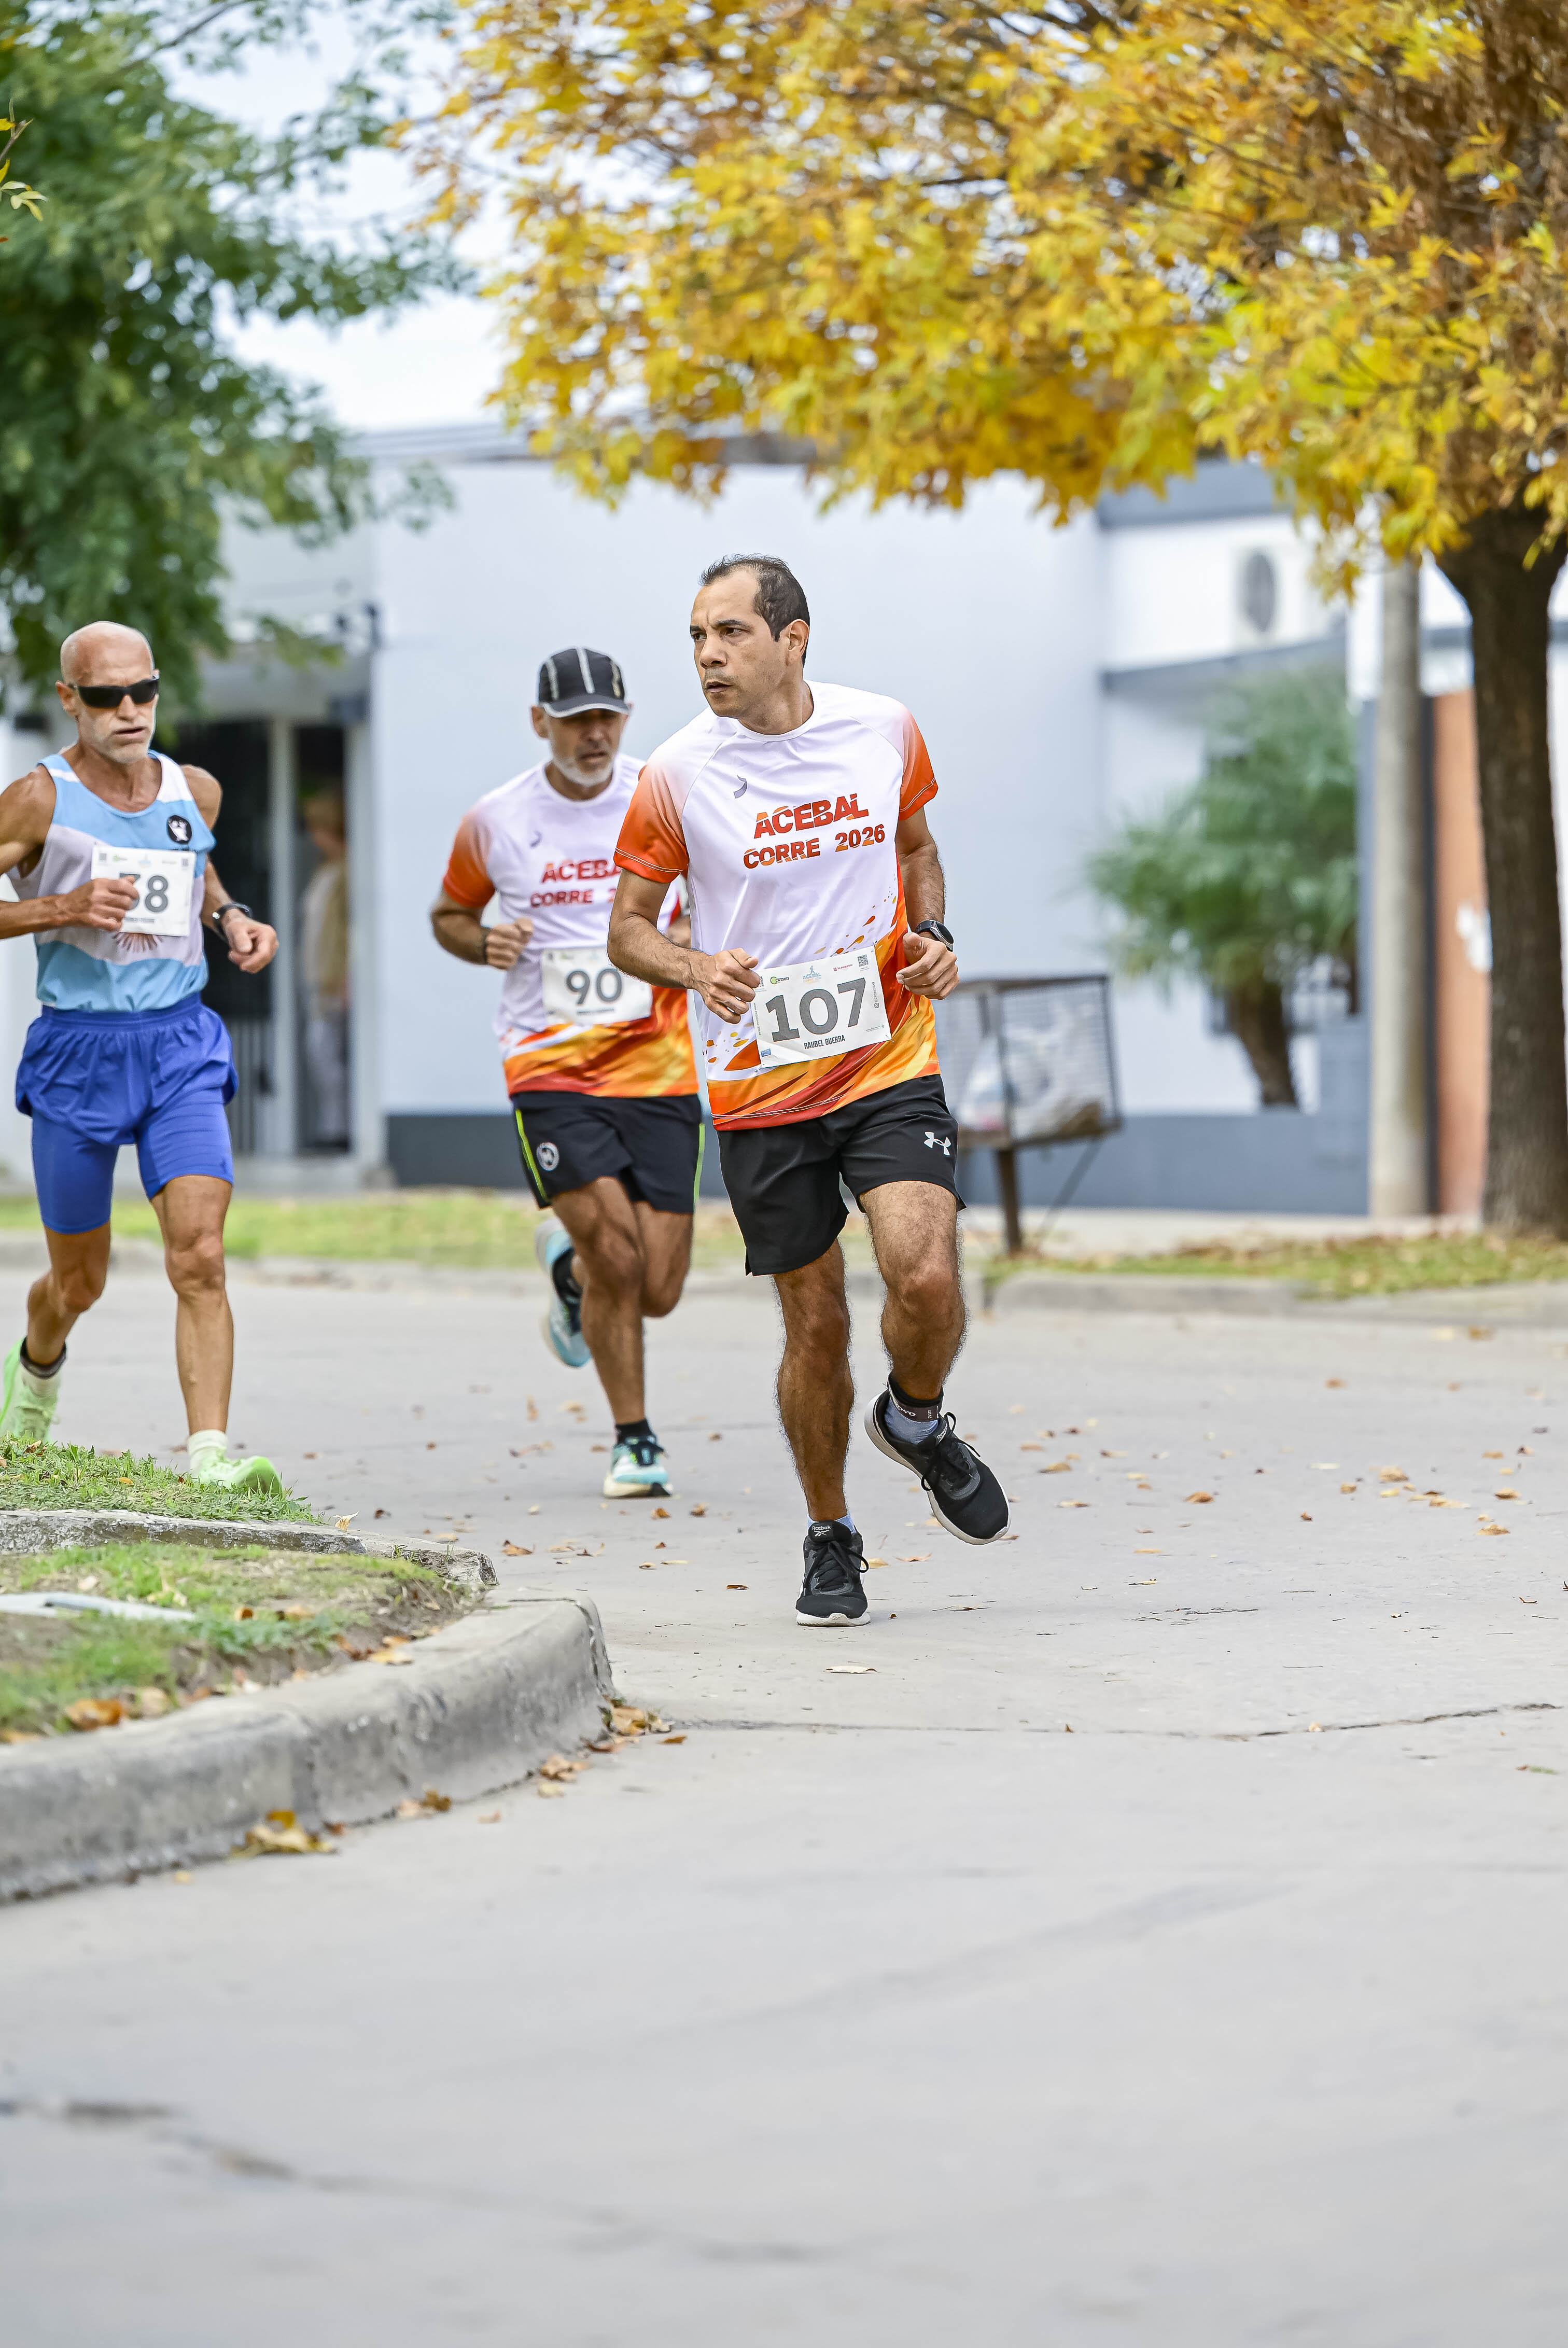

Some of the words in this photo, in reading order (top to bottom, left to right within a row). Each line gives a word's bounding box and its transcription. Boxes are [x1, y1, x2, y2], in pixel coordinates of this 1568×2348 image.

[753, 793, 869, 839] ACEBAL
[743, 837, 821, 869] CORRE
[835, 823, 885, 852] 2026
[540, 859, 622, 883] ACEB
[530, 889, 594, 907] CORRE
[566, 969, 622, 1005] 90
[765, 977, 866, 1042] 107
[804, 1040, 825, 1050] RAUBEL
[825, 1035, 846, 1045] GUERRA
